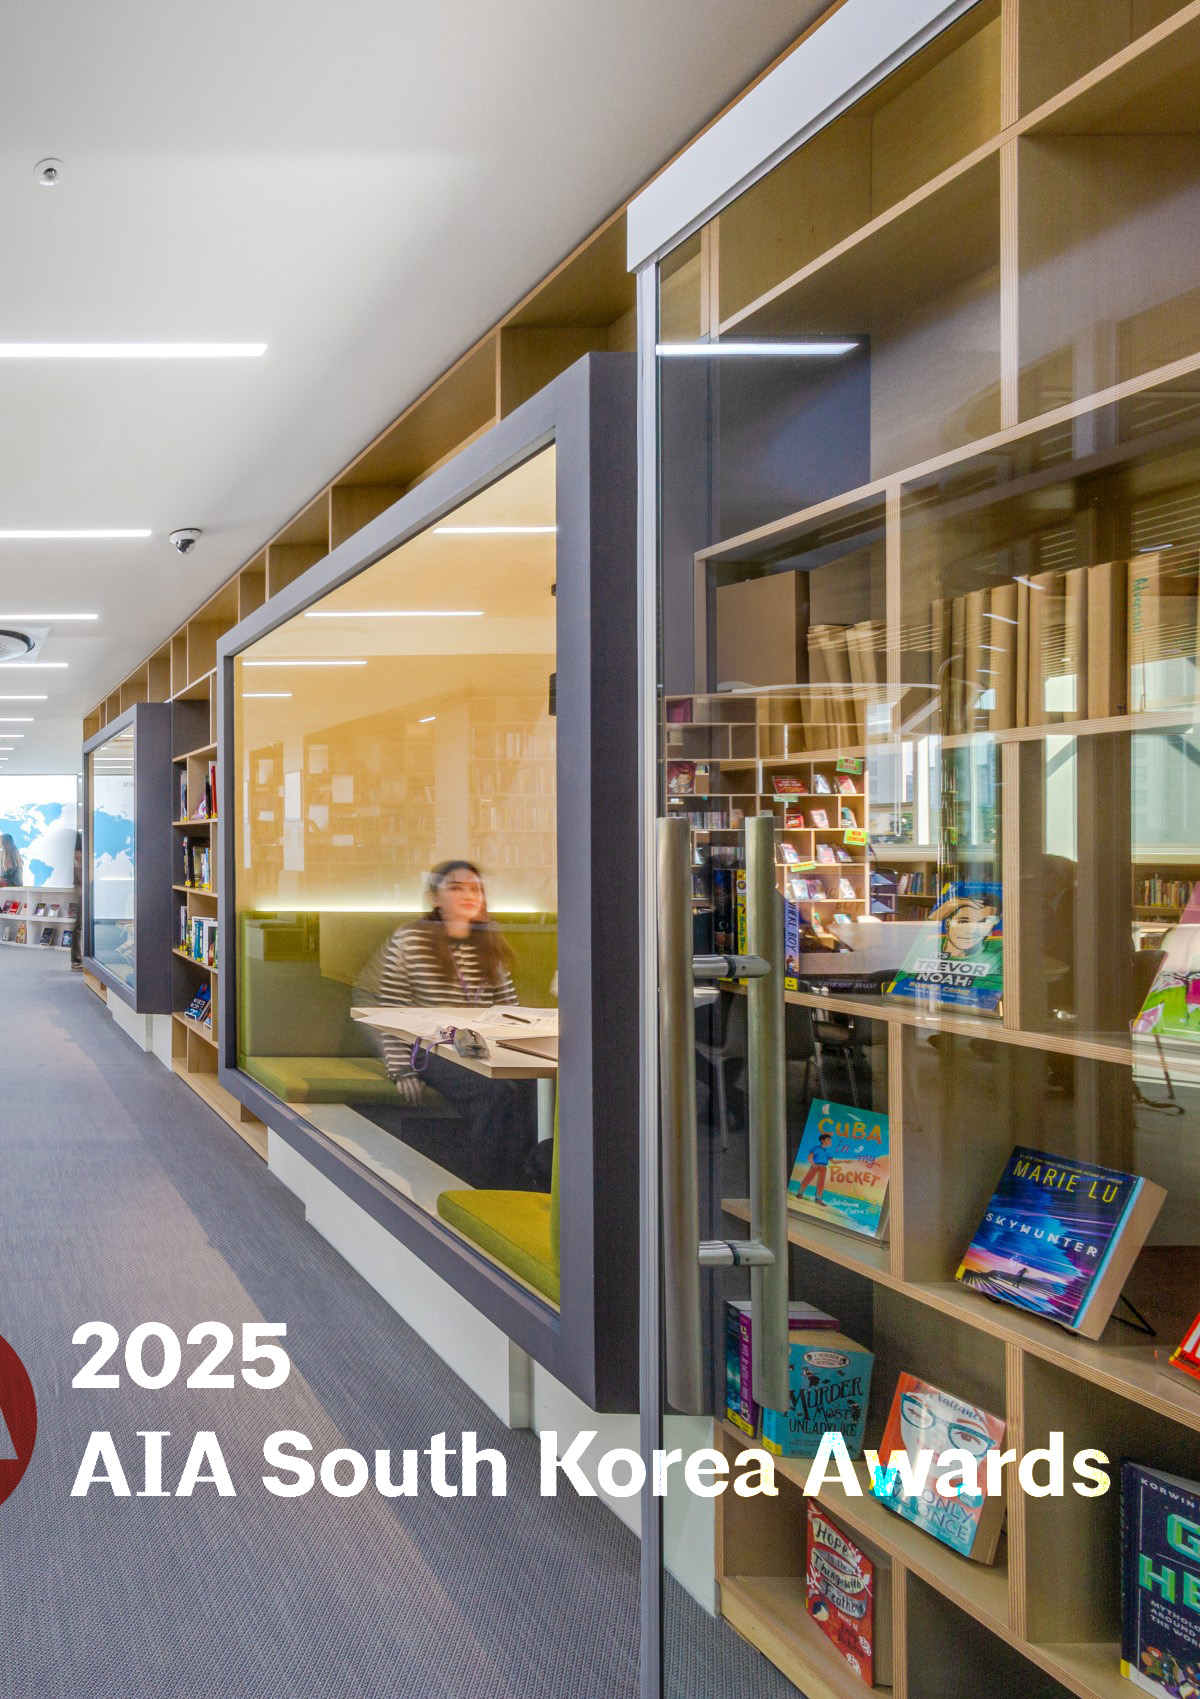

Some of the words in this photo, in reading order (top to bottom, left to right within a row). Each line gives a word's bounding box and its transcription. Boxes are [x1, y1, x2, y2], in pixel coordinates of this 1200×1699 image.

[787, 932, 797, 954] BOY
[915, 960, 986, 976] TREVOR
[916, 972, 972, 987] NOAH:
[836, 1140, 850, 1153] in
[856, 1156, 881, 1168] my
[828, 1165, 882, 1187] POCKET
[1013, 1160, 1081, 1193] MARIE
[1088, 1180, 1118, 1203] LU
[985, 1212, 1098, 1257] SKYHUNTER
[789, 1377, 863, 1421] MURDER
[922, 1488, 974, 1523] ONLY
[1140, 1477, 1196, 1509] KORWIN
[916, 1502, 968, 1542] ONCE
[815, 1520, 851, 1558] Hope
[844, 1577, 863, 1590] with
[1150, 1608, 1196, 1637] AROUND
[1150, 1614, 1171, 1631] THE
